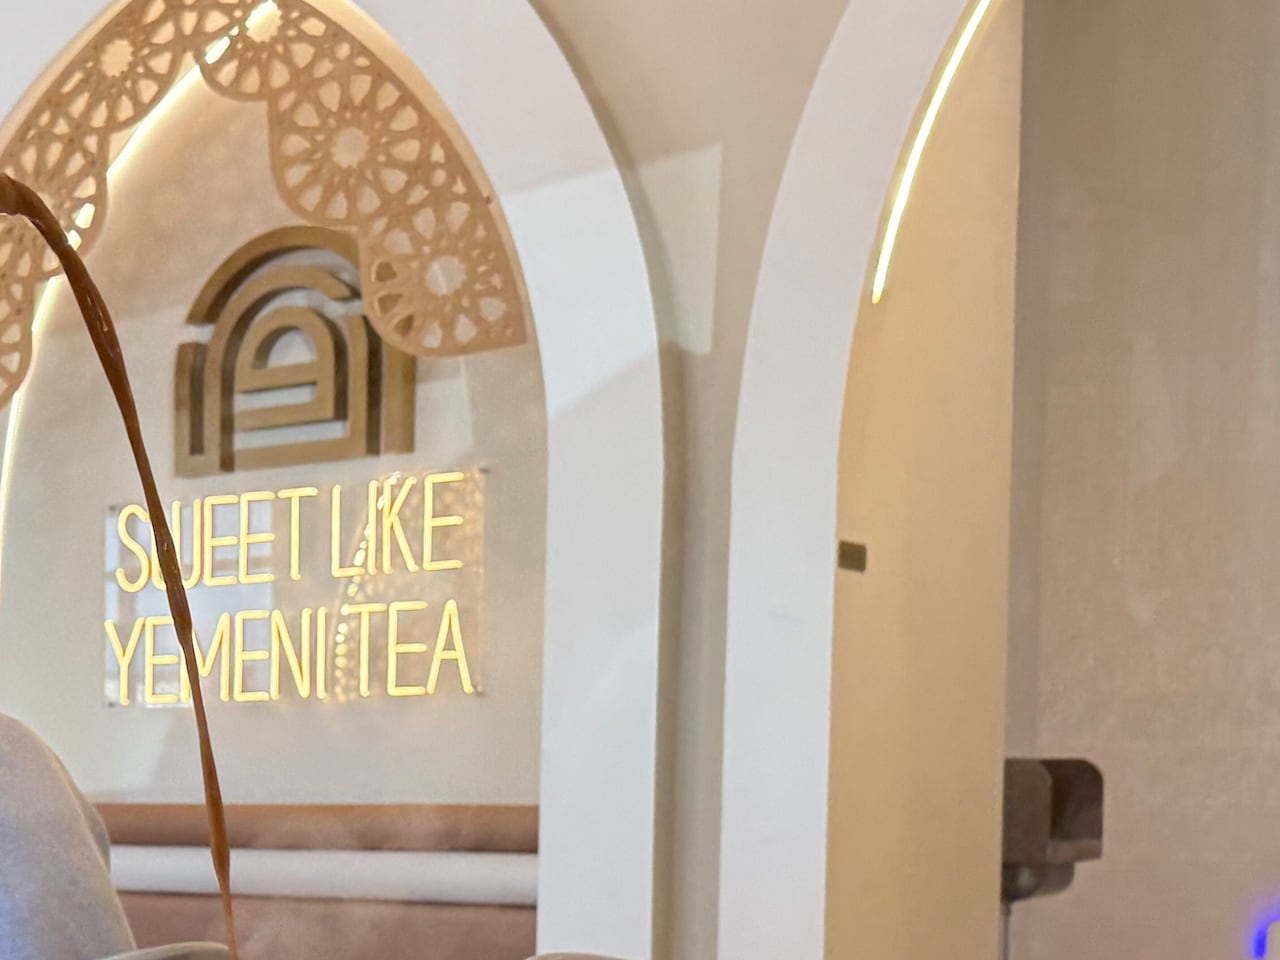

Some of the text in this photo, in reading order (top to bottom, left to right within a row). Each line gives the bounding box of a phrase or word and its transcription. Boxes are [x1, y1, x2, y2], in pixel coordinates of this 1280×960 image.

[115, 471, 464, 593] SWEET LIKE
[104, 599, 474, 706] YEMENI TEA
